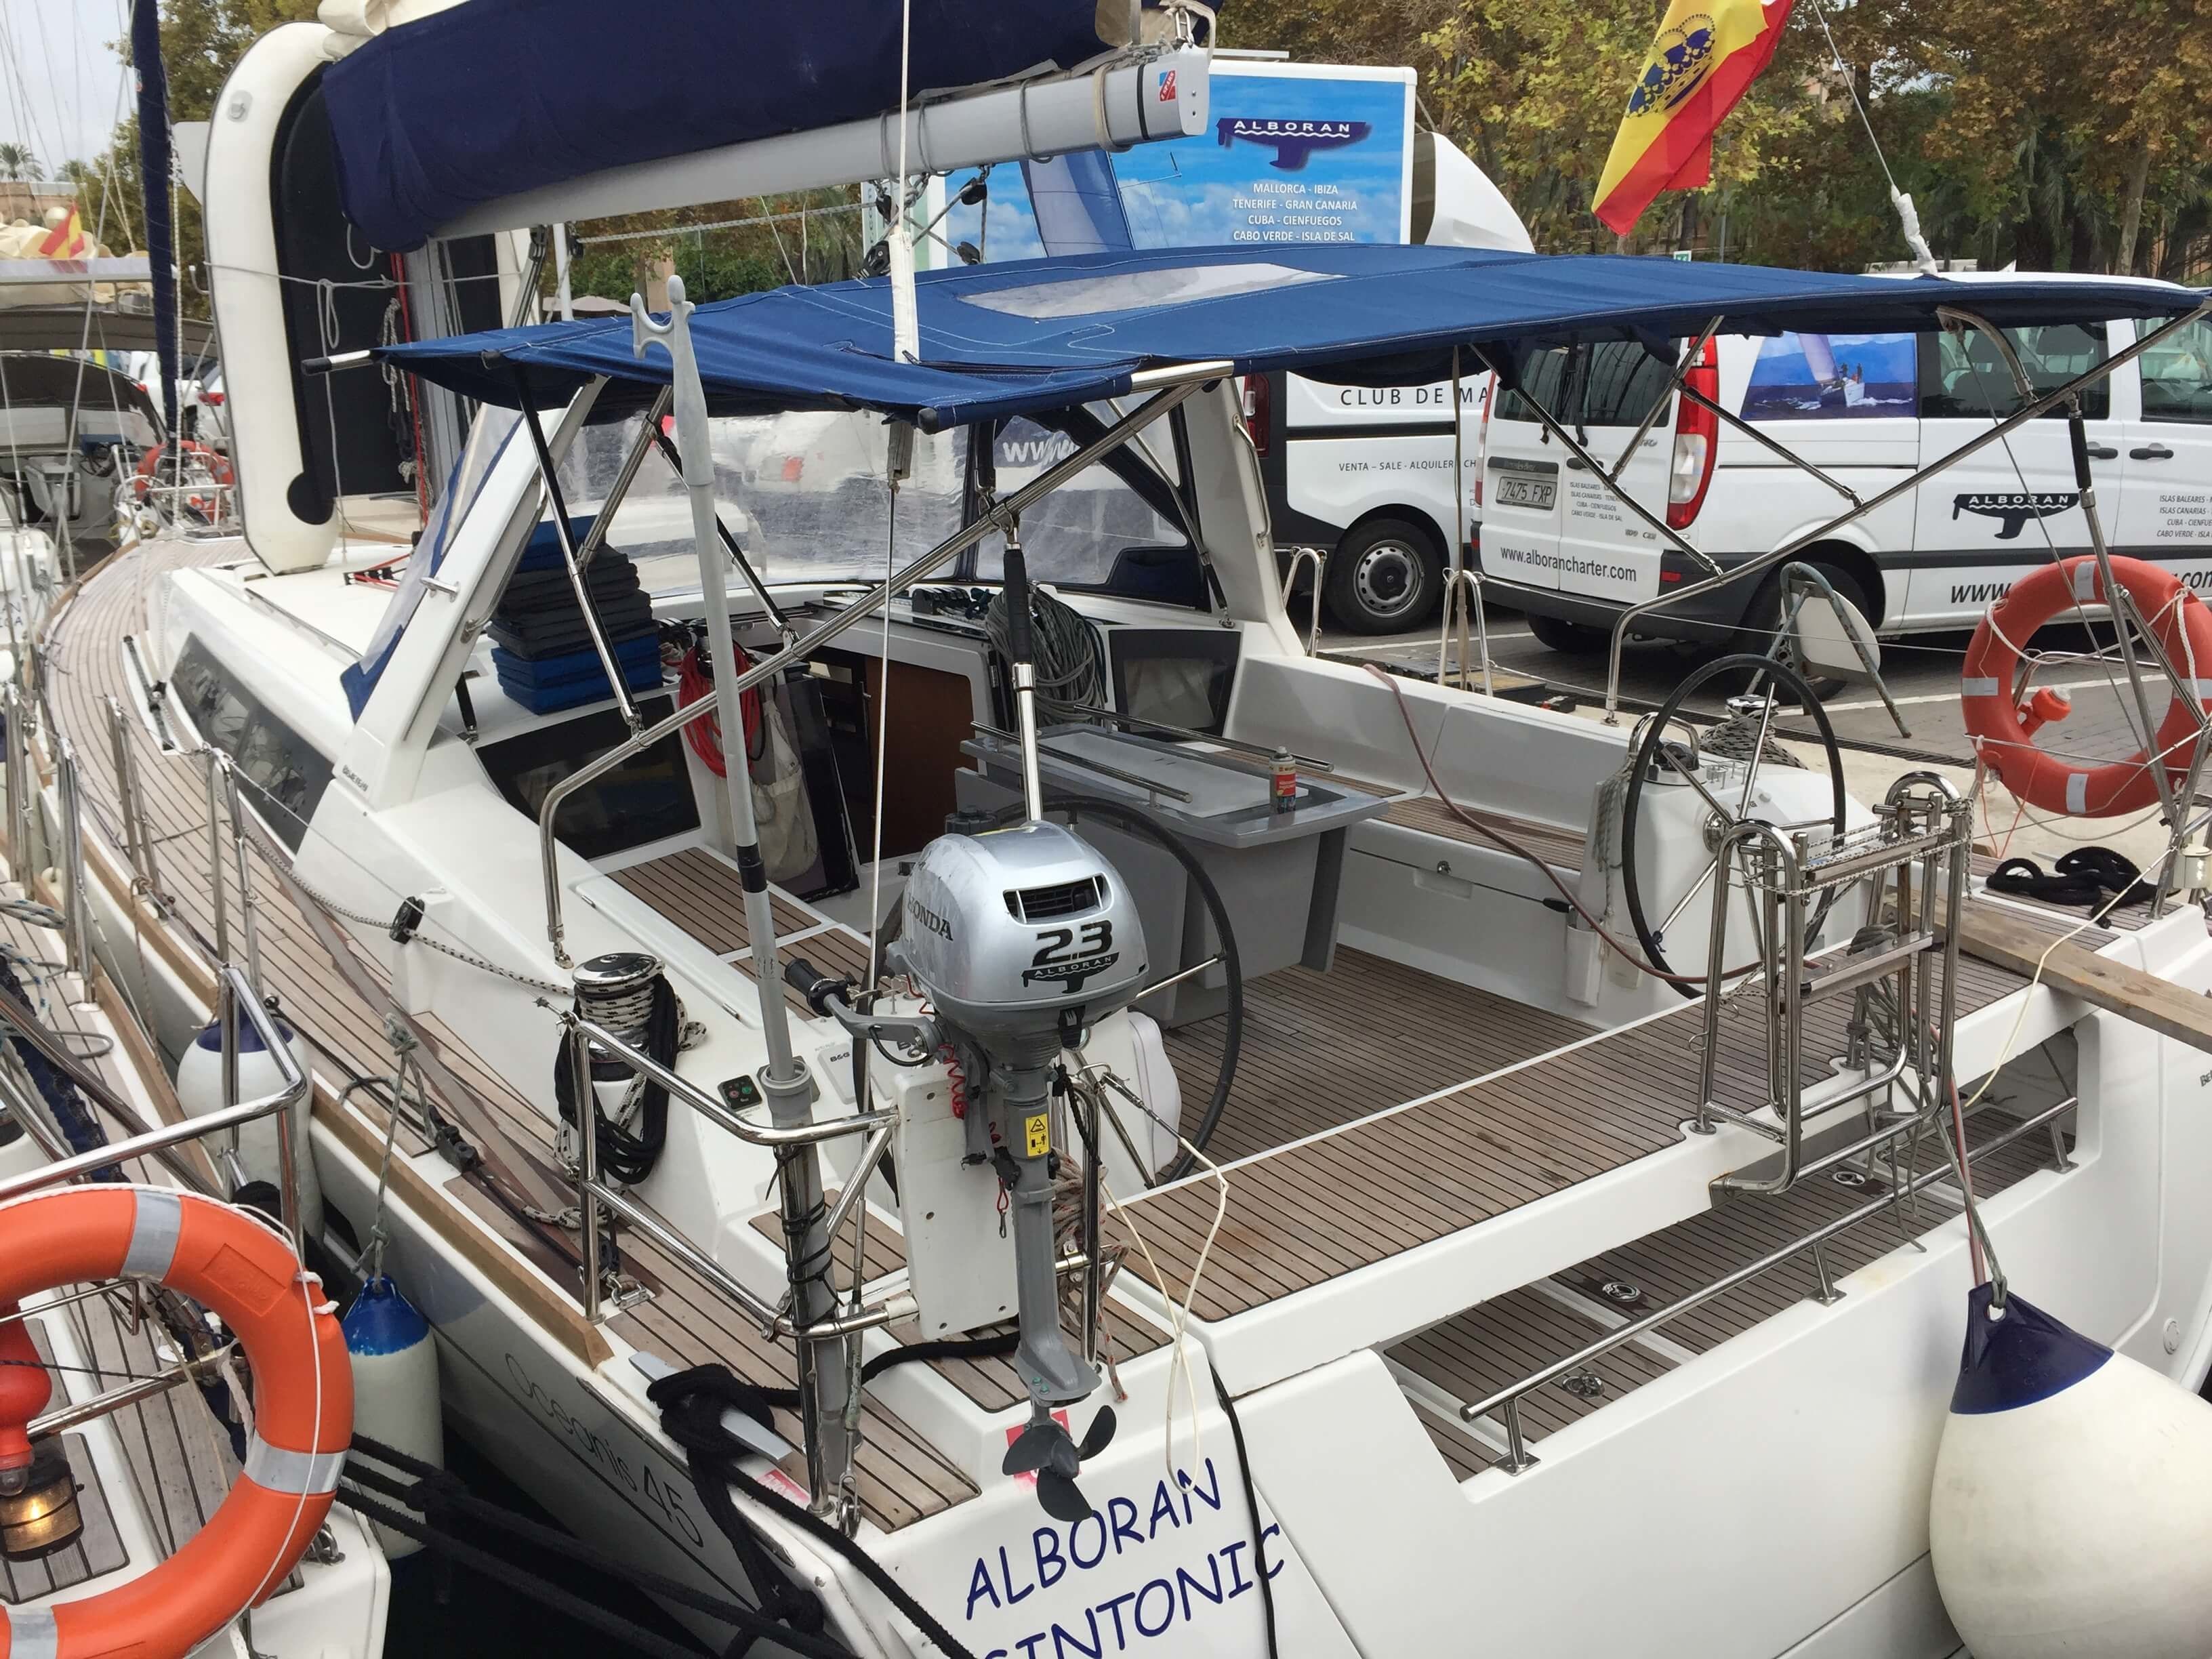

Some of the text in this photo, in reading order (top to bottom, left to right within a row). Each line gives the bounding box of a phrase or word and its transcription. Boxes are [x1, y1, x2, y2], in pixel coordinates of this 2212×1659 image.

[1234, 121, 1350, 132] ALBORAN
[1254, 184, 1306, 194] MALLORCA
[1314, 184, 1338, 194] IBIZA
[1233, 199, 1277, 209] TENERIFE
[1285, 200, 1313, 209] GRAN
[1315, 201, 1357, 210] CANARIA
[1248, 215, 1275, 224] CUBA
[1283, 216, 1342, 226] CIENFUEGOS
[1233, 230, 1260, 241] CABO
[1263, 231, 1293, 241] VERDE
[1302, 232, 1322, 241] ISLA
[1324, 232, 1336, 241] DE
[1338, 232, 1355, 241] SAL
[1340, 388, 1401, 405] CLUB
[1416, 388, 1443, 404] DE
[1339, 463, 1369, 471] VENTA
[1379, 462, 1402, 470] SALE
[1410, 460, 1454, 469] ALQUILER
[1504, 481, 1552, 503] 7475 FXP
[1969, 495, 2068, 504] ALBORAN
[1500, 547, 1637, 581] www.alborancharter.com
[907, 893, 954, 941] HONDA
[1035, 956, 1111, 976] ALBORAN
[830, 1052, 850, 1062] B&G
[506, 1353, 704, 1548] Oceanis 45
[966, 1458, 1221, 1620] ALBORAN
